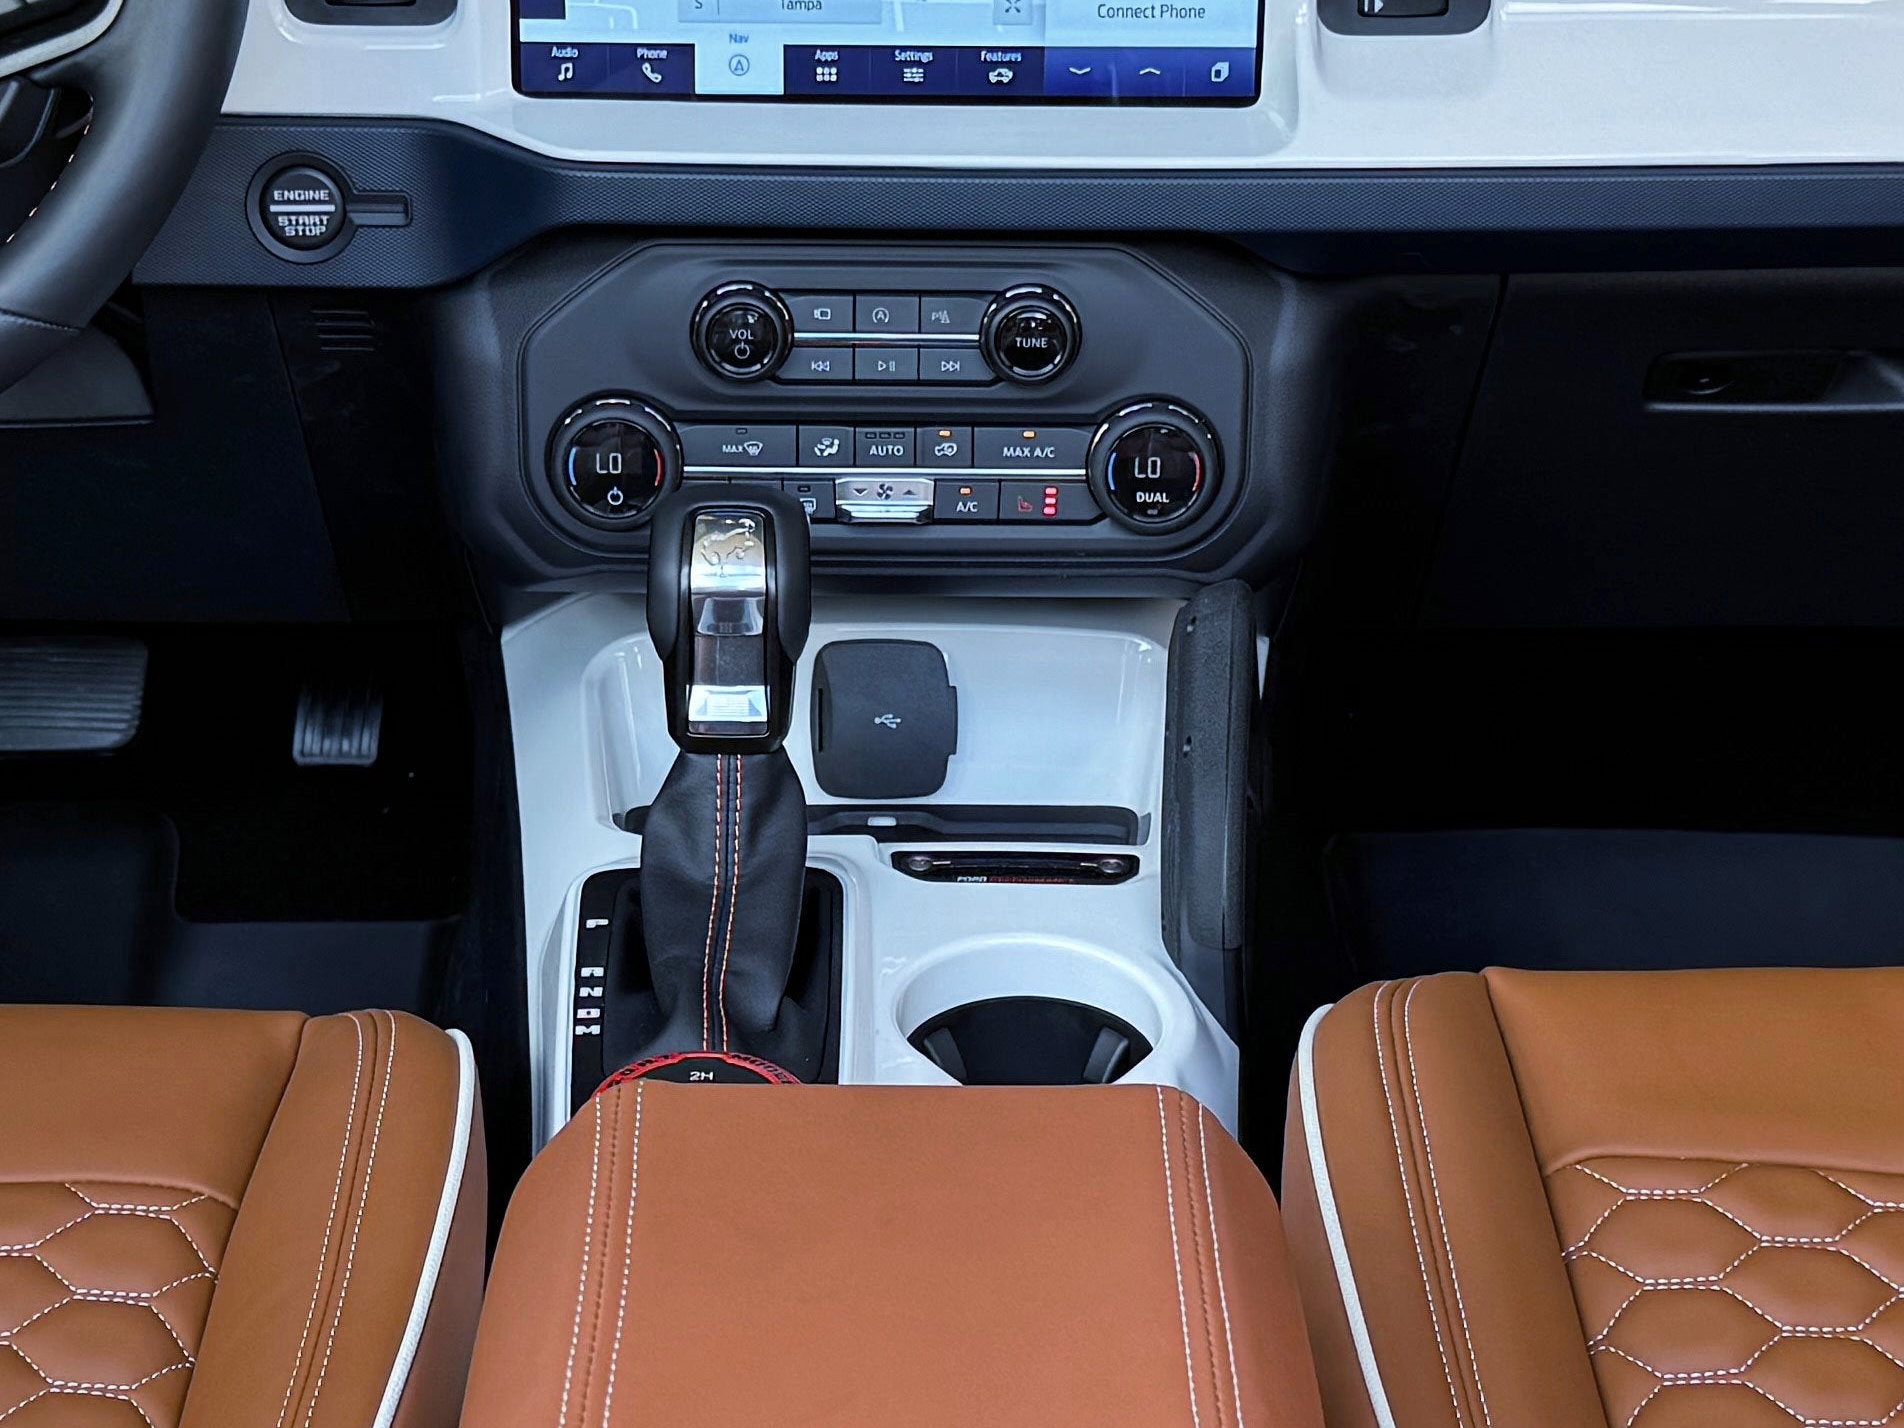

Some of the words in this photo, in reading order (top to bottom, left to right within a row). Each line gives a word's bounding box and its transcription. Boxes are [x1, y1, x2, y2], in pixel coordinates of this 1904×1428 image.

[1097, 3, 1157, 20] Connect
[1159, 3, 1206, 20] Phone
[728, 33, 749, 44] Nav
[551, 46, 578, 58] Audio
[636, 47, 668, 60] Phone
[814, 50, 838, 62] Apps
[894, 49, 934, 63] Settings
[980, 51, 1022, 62] Features
[273, 189, 330, 201] ENGINE
[277, 215, 330, 226] START
[284, 226, 327, 237] STOP
[729, 329, 754, 340] VOL
[1015, 337, 1048, 348] TUNE
[722, 443, 744, 454] MAX
[869, 445, 904, 456] AUTO
[1002, 446, 1032, 458] MAX
[1033, 446, 1056, 458] A/C
[595, 452, 622, 474] LO
[1134, 457, 1161, 479] LO
[1136, 491, 1170, 503] DUAL
[956, 501, 978, 512] A/C
[586, 918, 609, 928] P
[579, 987, 603, 997] N
[576, 1008, 600, 1019] D
[575, 1025, 600, 1035] M
[689, 1071, 714, 1082] 2H
